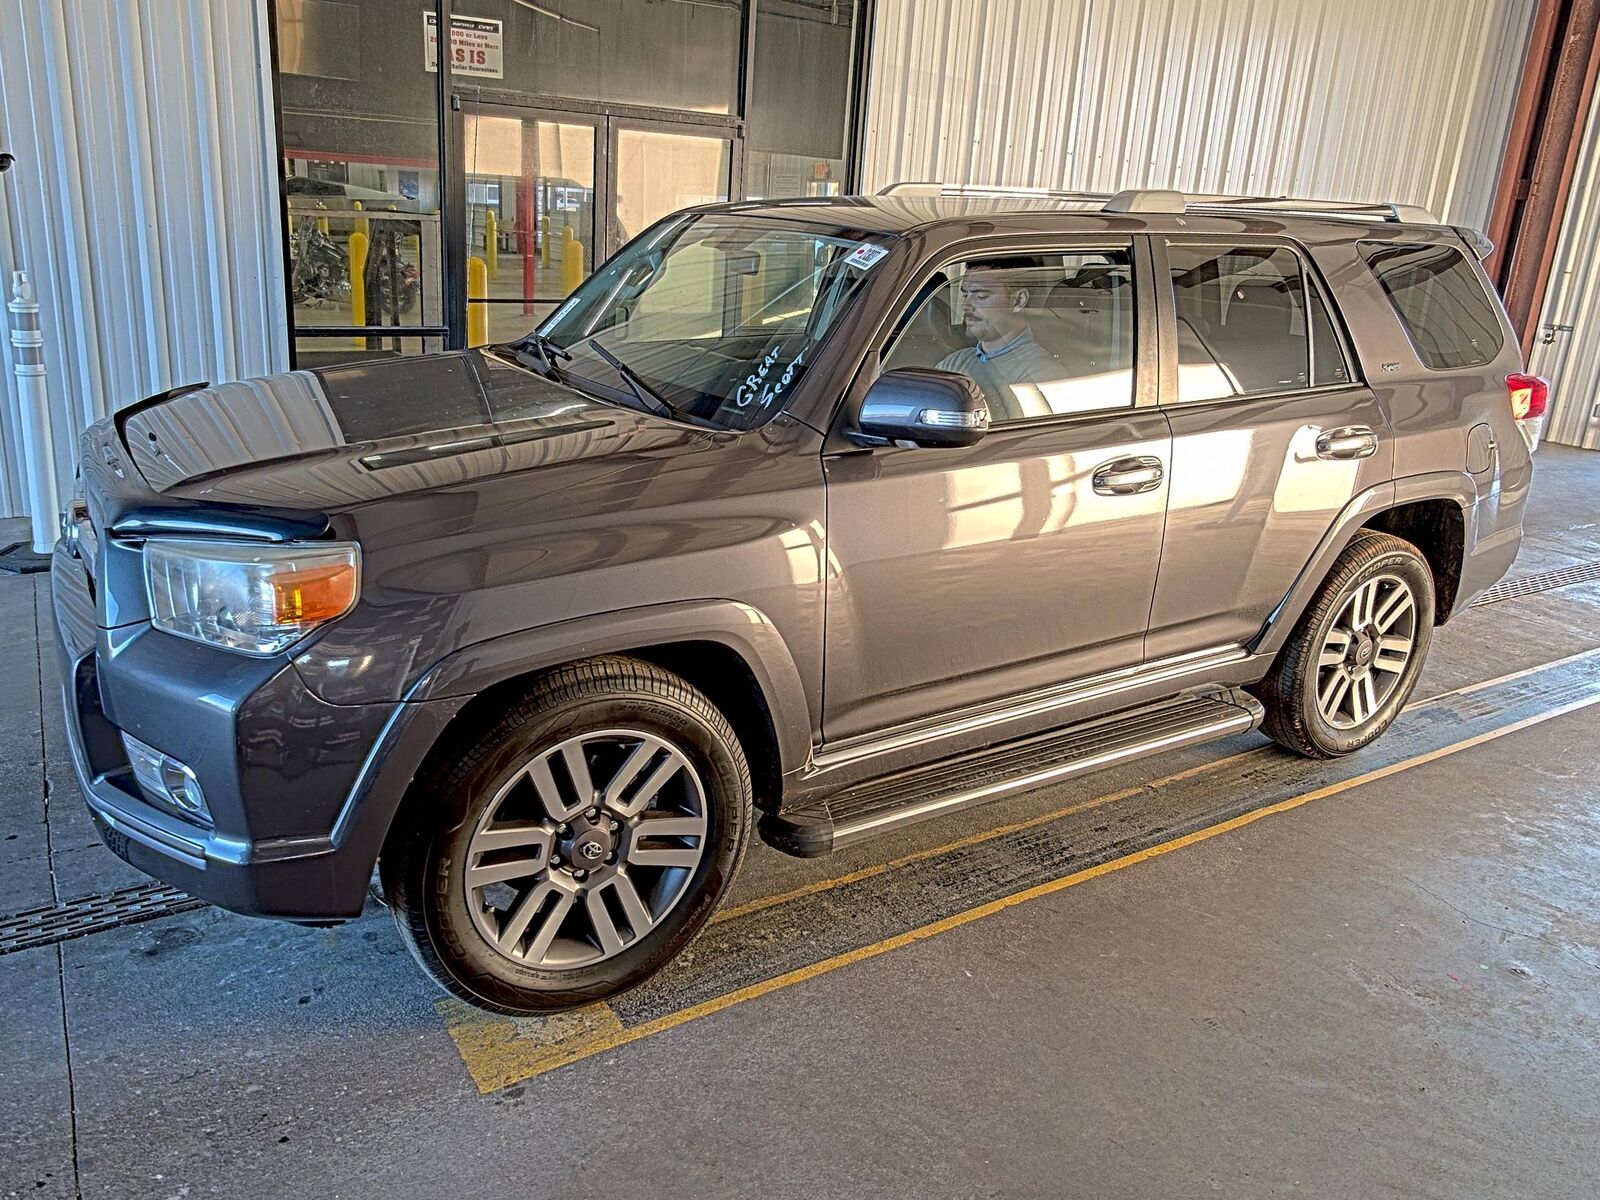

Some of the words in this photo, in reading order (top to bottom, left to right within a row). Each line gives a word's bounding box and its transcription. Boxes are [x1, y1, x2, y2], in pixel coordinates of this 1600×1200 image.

[469, 50, 486, 65] IS
[1358, 557, 1403, 583] COOPER
[1346, 719, 1388, 748] COOPER
[717, 760, 739, 853] COOPER
